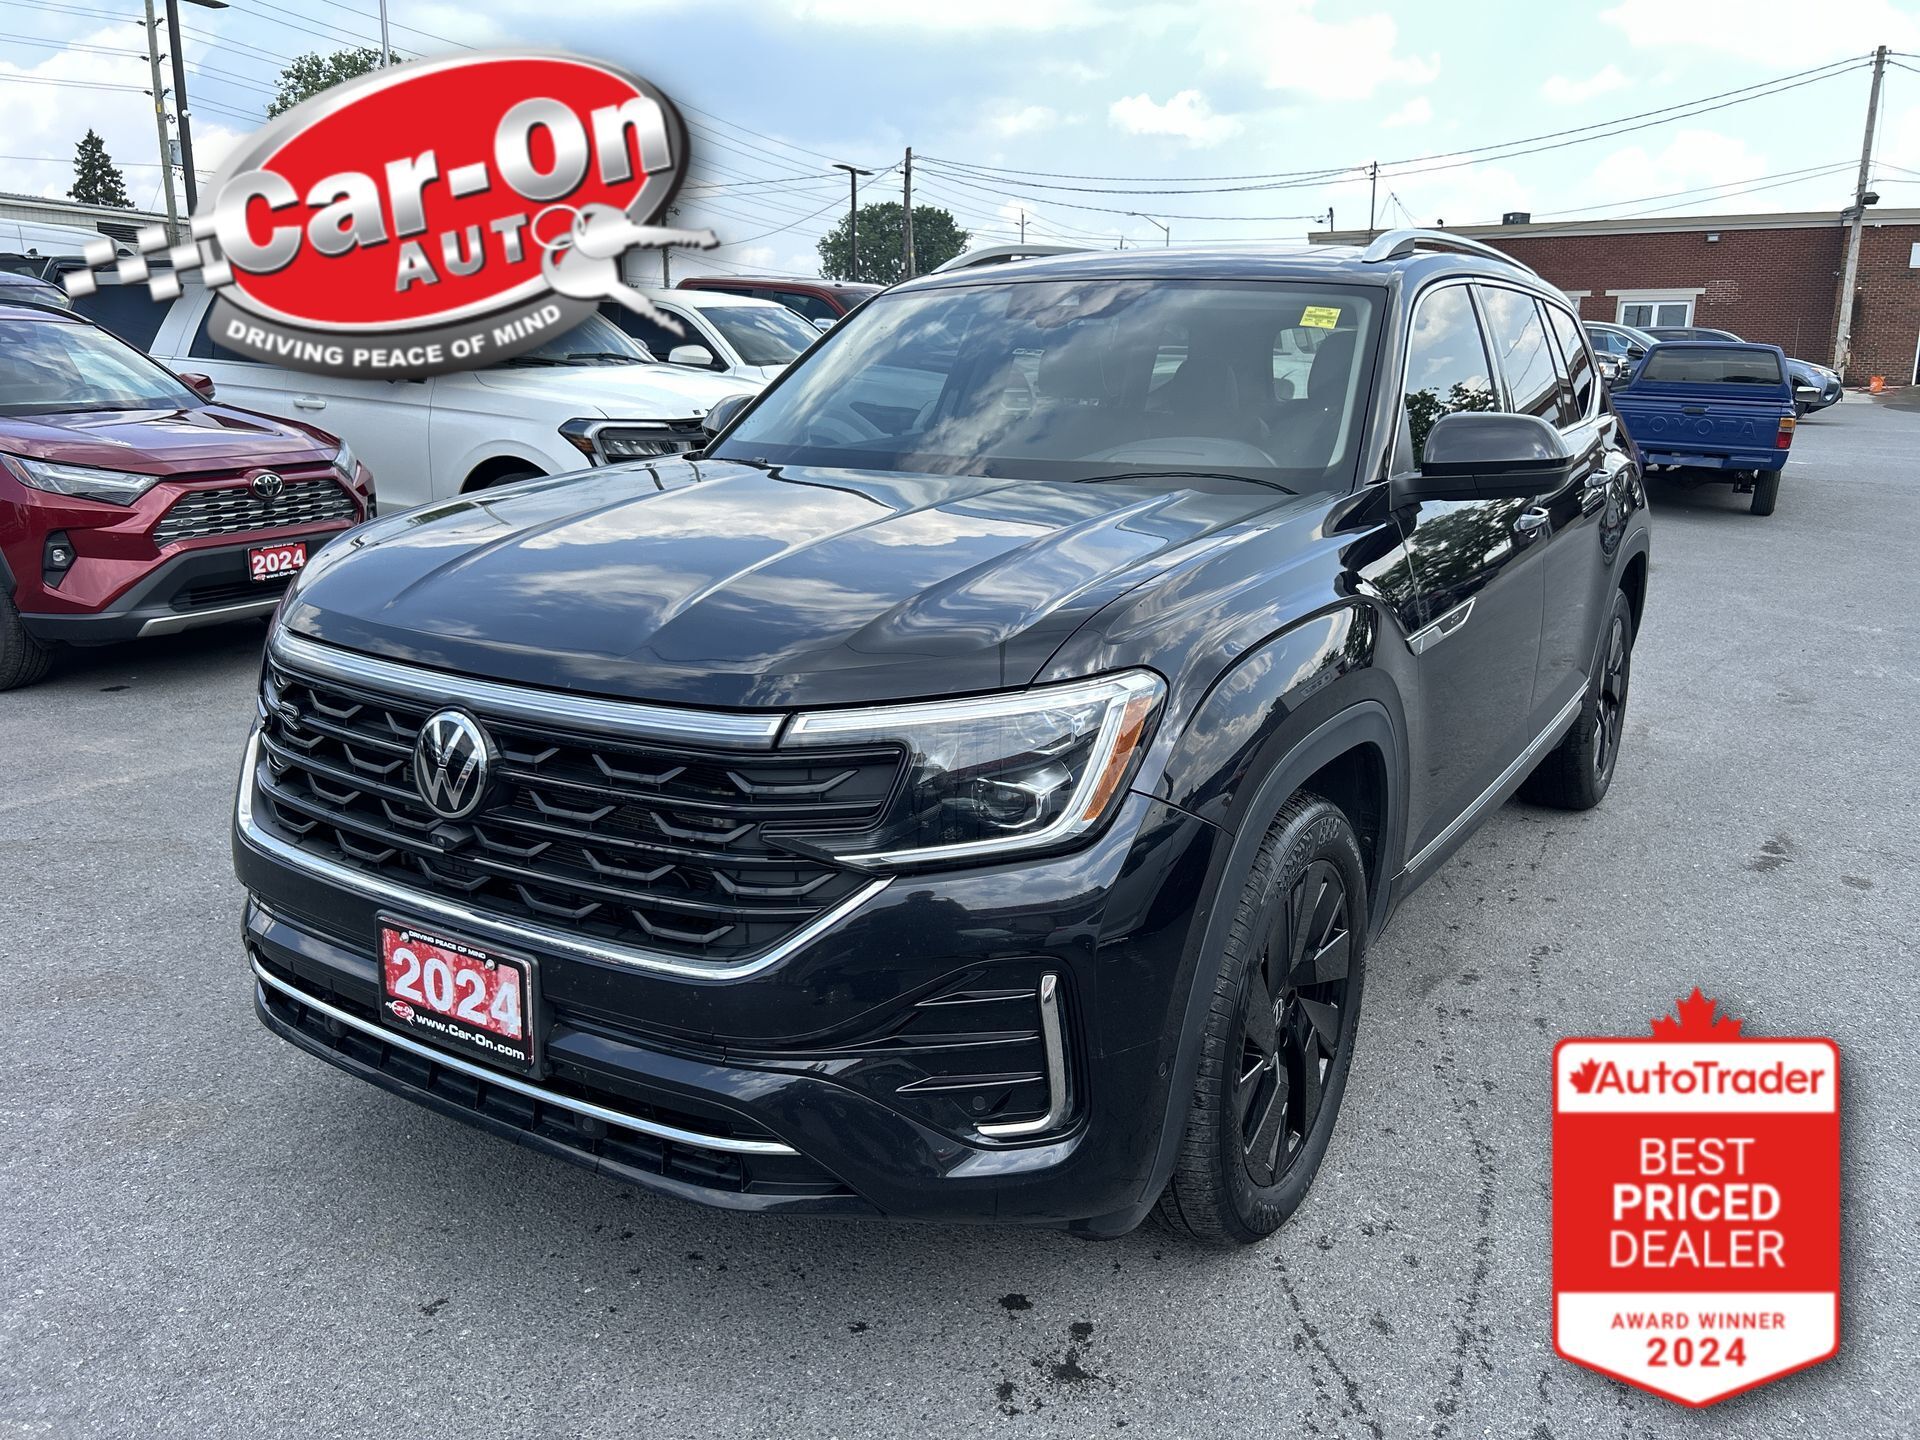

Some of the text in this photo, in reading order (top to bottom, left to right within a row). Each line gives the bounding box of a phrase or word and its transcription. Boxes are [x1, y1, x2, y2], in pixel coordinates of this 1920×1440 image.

[1628, 414, 1757, 440] TOYOTA
[252, 548, 305, 575] 2024
[408, 930, 487, 960] DRIVING PEACE OF MIND
[392, 947, 522, 1036] 2024
[416, 1013, 526, 1061] www.Car-On.com
